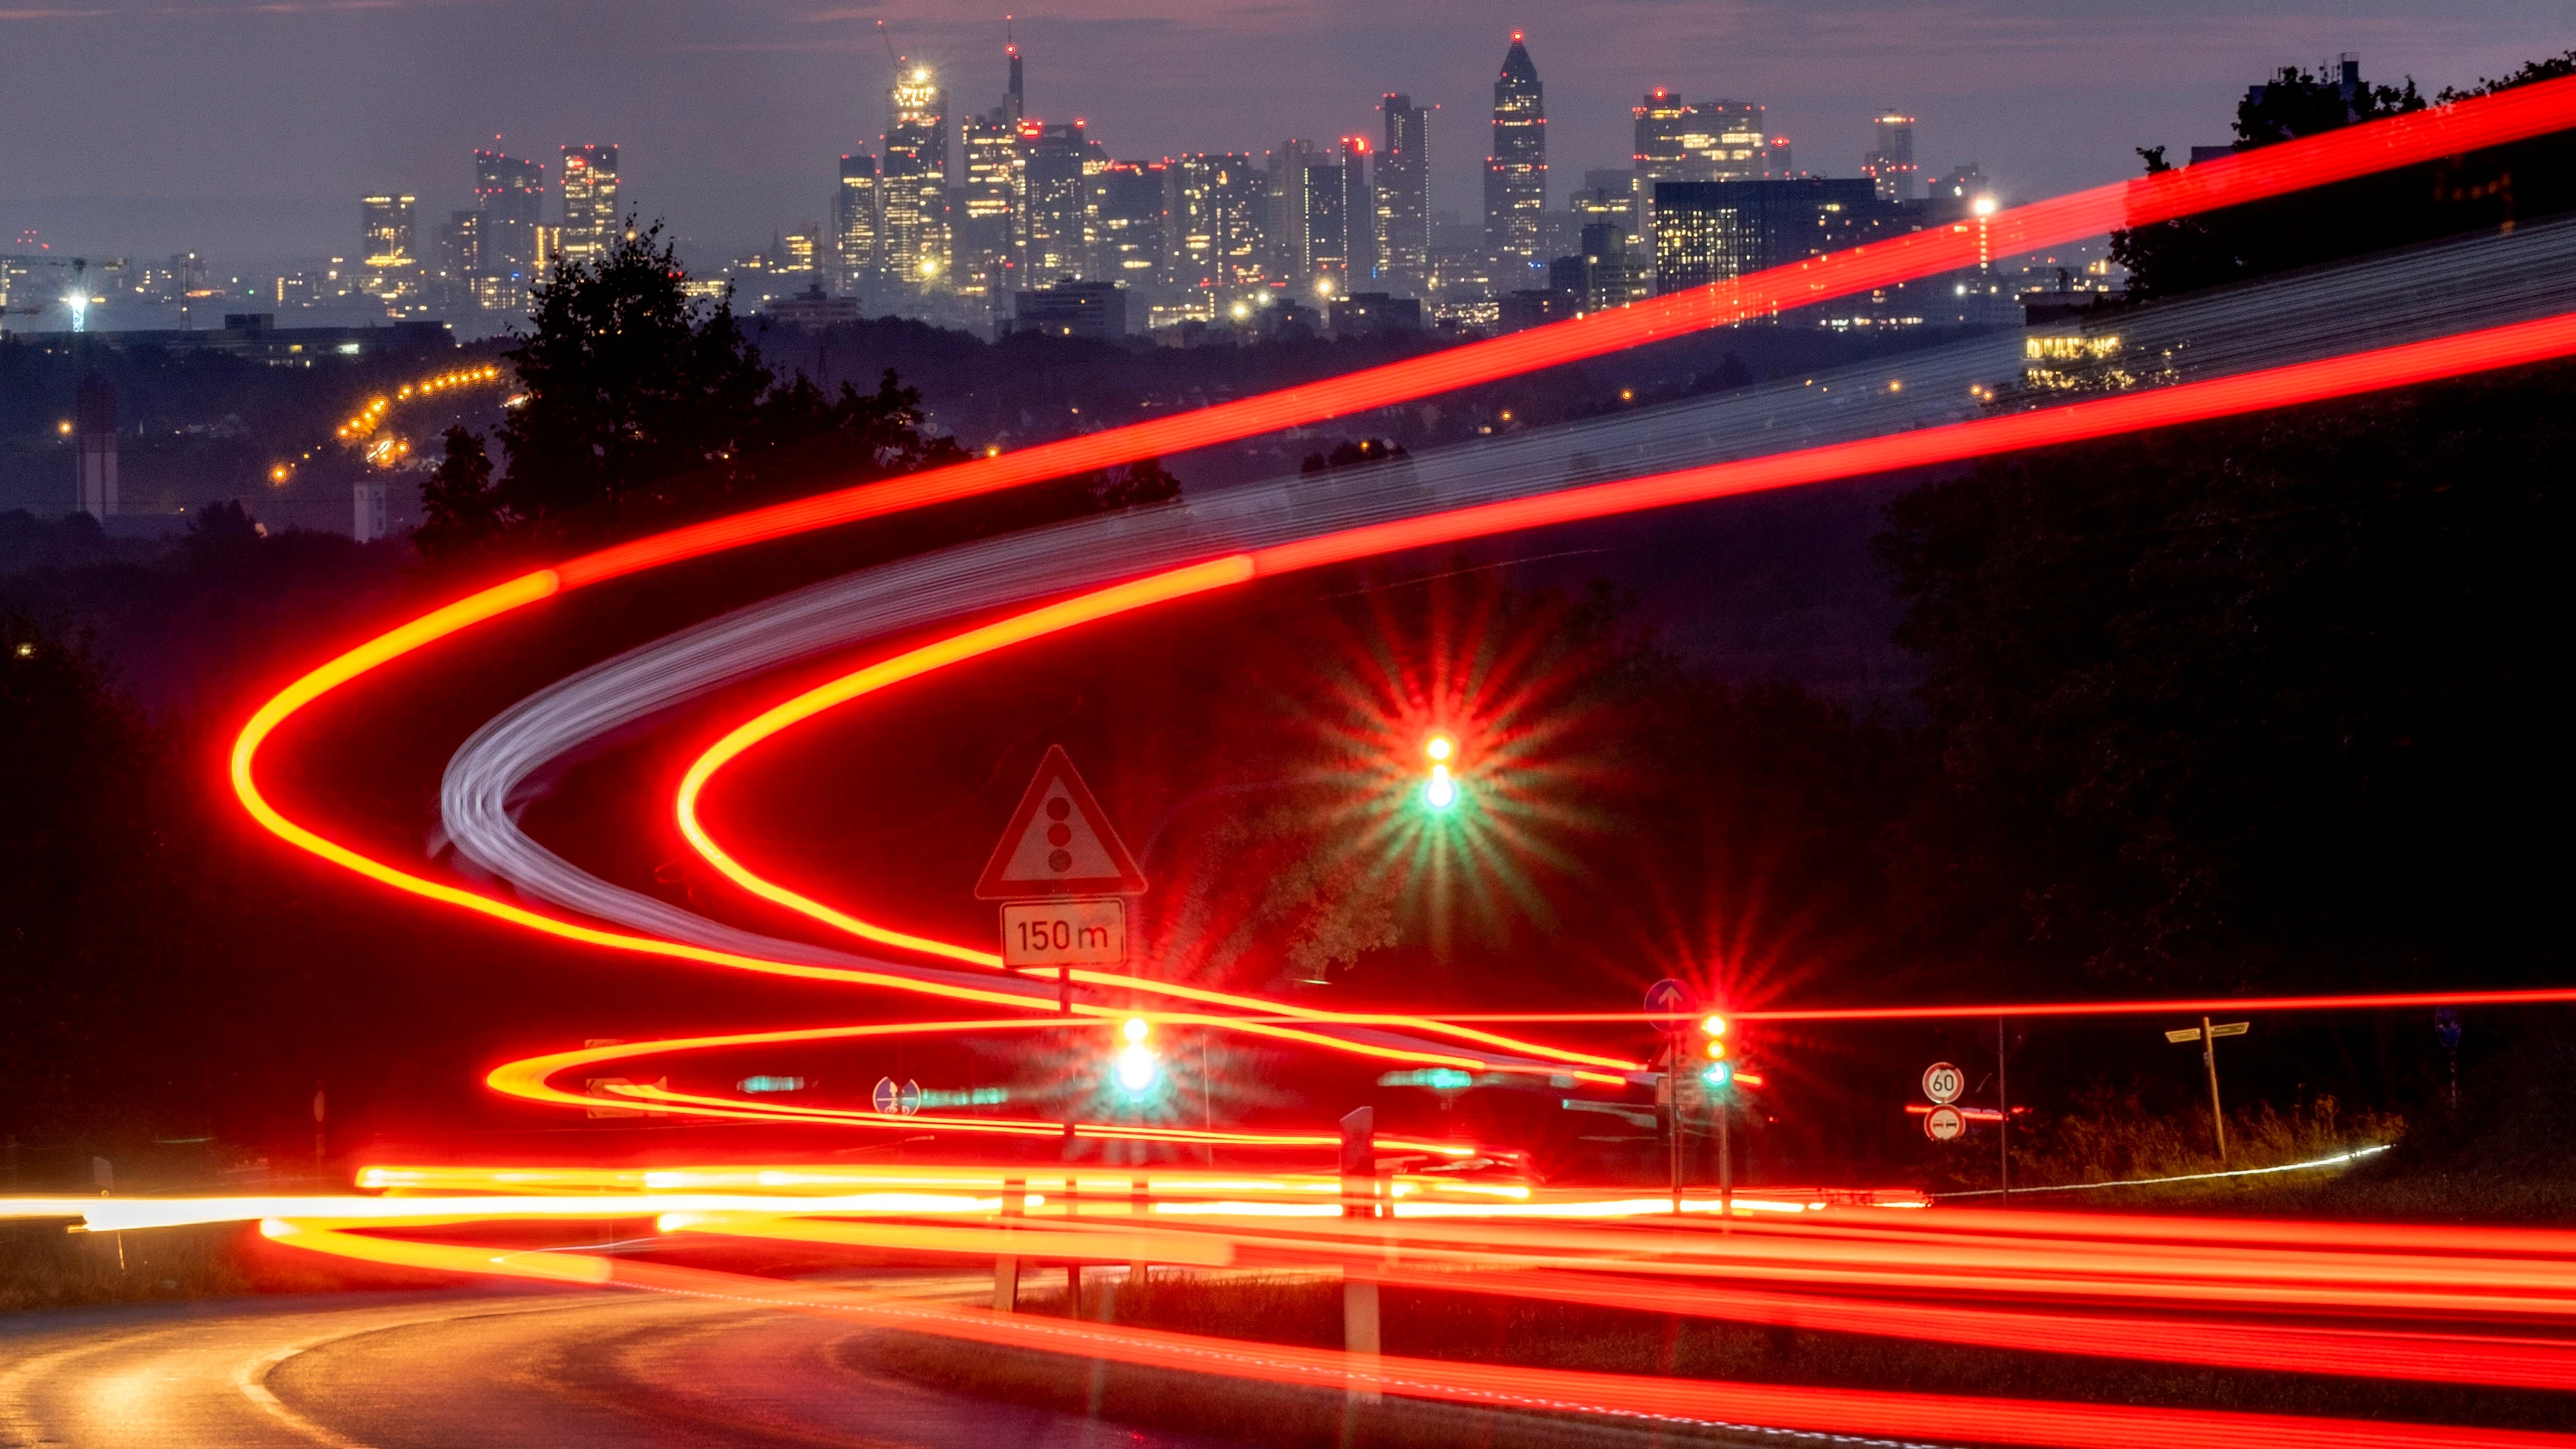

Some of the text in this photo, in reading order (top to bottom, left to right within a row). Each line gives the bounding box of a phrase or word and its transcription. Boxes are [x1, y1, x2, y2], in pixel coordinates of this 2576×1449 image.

[1018, 920, 1108, 951] 150 m
[1933, 1074, 1954, 1092] 60
